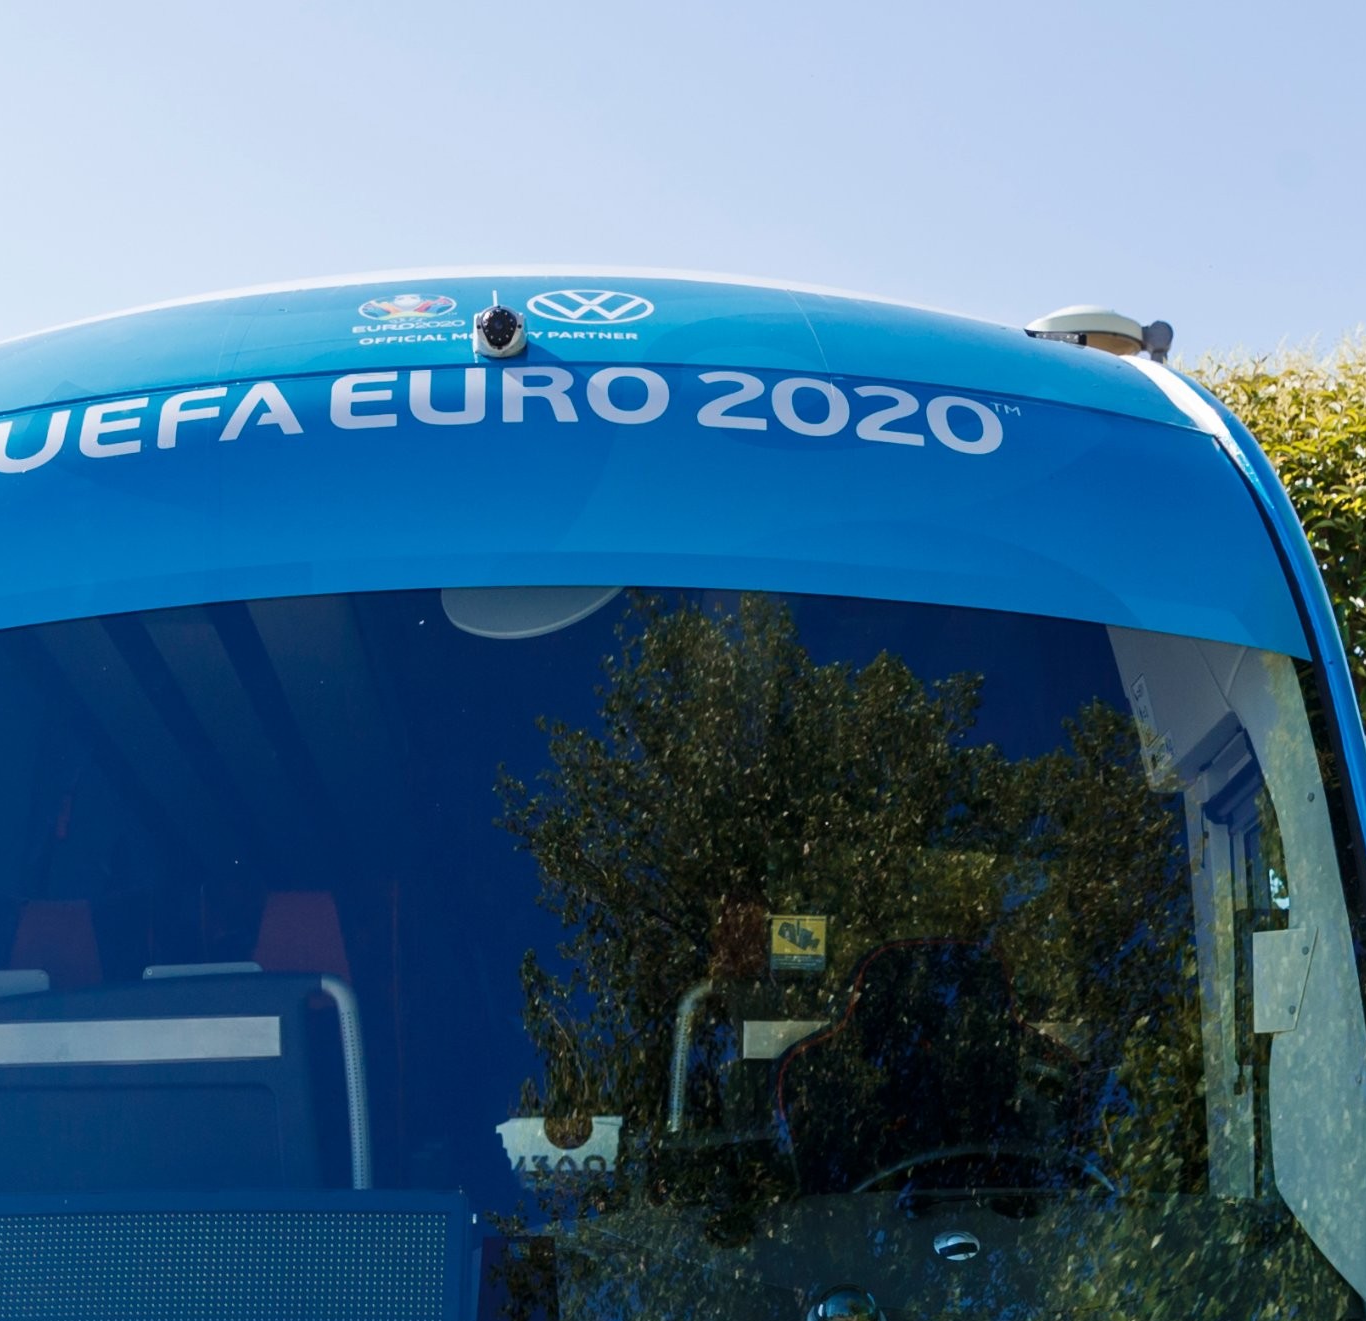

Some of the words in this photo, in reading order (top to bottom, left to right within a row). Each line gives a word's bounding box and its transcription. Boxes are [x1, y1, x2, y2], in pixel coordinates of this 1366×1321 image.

[359, 333, 447, 345] OFFICIAL
[547, 331, 638, 340] PARTNER
[330, 366, 669, 429] EURO
[698, 370, 1003, 454] 2020
